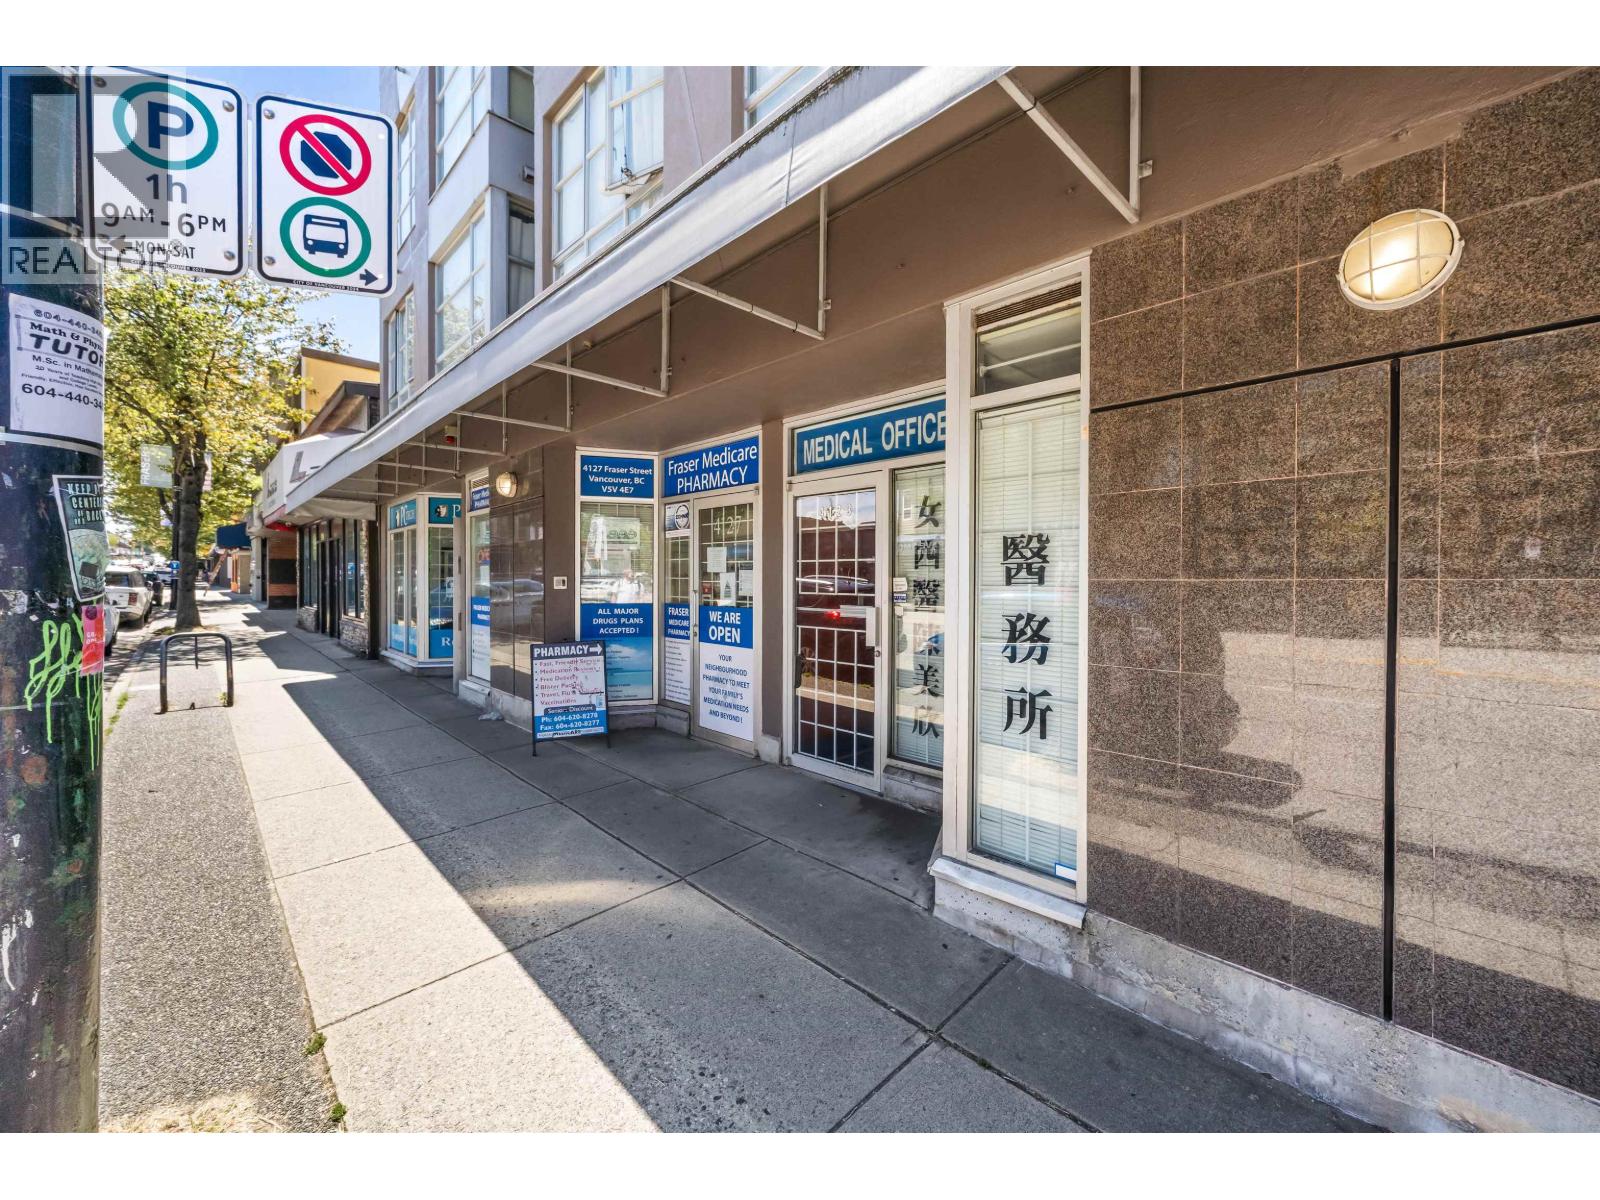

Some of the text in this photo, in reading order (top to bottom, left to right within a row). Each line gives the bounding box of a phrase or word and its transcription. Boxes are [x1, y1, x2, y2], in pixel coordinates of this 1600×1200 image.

[146, 173, 188, 204] 1h
[29, 321, 67, 338] Math
[70, 332, 81, 341] &
[803, 410, 947, 465] MEDICAL OFFICE
[668, 445, 758, 476] Fraser Medicare
[582, 465, 653, 475] 4127 Fraser Street
[588, 475, 645, 485] Vancouver, BC
[677, 465, 748, 495] PHARMACY
[601, 485, 634, 494] V5V 4E7
[613, 607, 639, 615] MAJOR
[668, 607, 690, 617] FRASER
[708, 610, 741, 625] WE ARE
[592, 617, 618, 625] DRUGS
[708, 626, 740, 644] OPEN
[1000, 532, 1053, 740] 醫務所
[534, 644, 589, 658] PHARMACY
[719, 654, 732, 662] YOUR
[702, 674, 750, 689] PHARMACY TO MEET
[708, 686, 722, 696] YOUR
[703, 696, 750, 714] MEDICATION NEEDS
[708, 709, 720, 718] AND
[540, 723, 554, 731] Fax:
